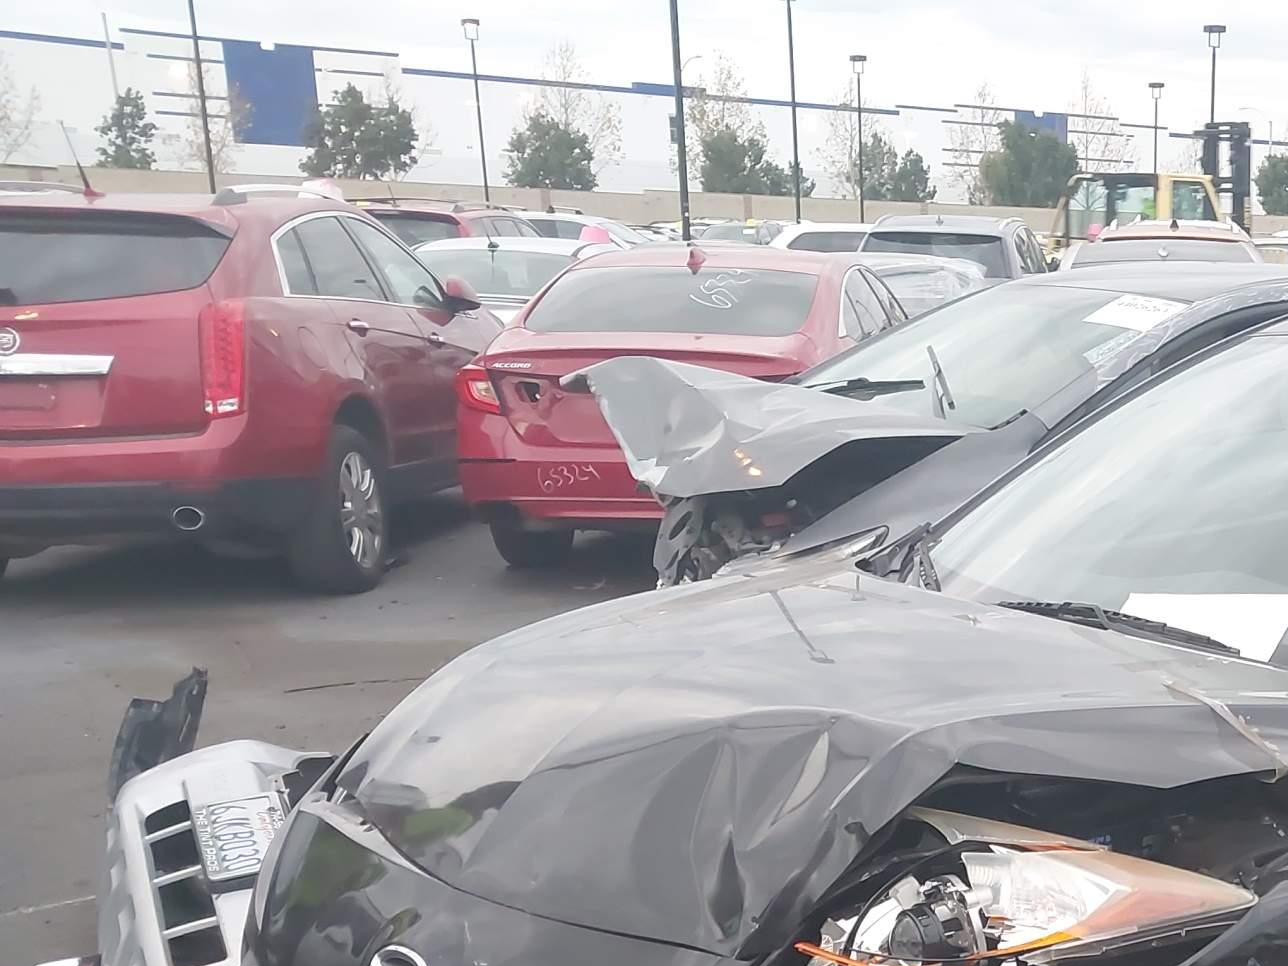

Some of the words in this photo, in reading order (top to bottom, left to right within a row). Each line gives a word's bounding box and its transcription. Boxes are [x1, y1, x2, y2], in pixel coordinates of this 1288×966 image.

[537, 464, 601, 494] 65324
[194, 808, 207, 826] THE
[198, 826, 213, 846] TINT
[209, 805, 262, 872] 6JKB030
